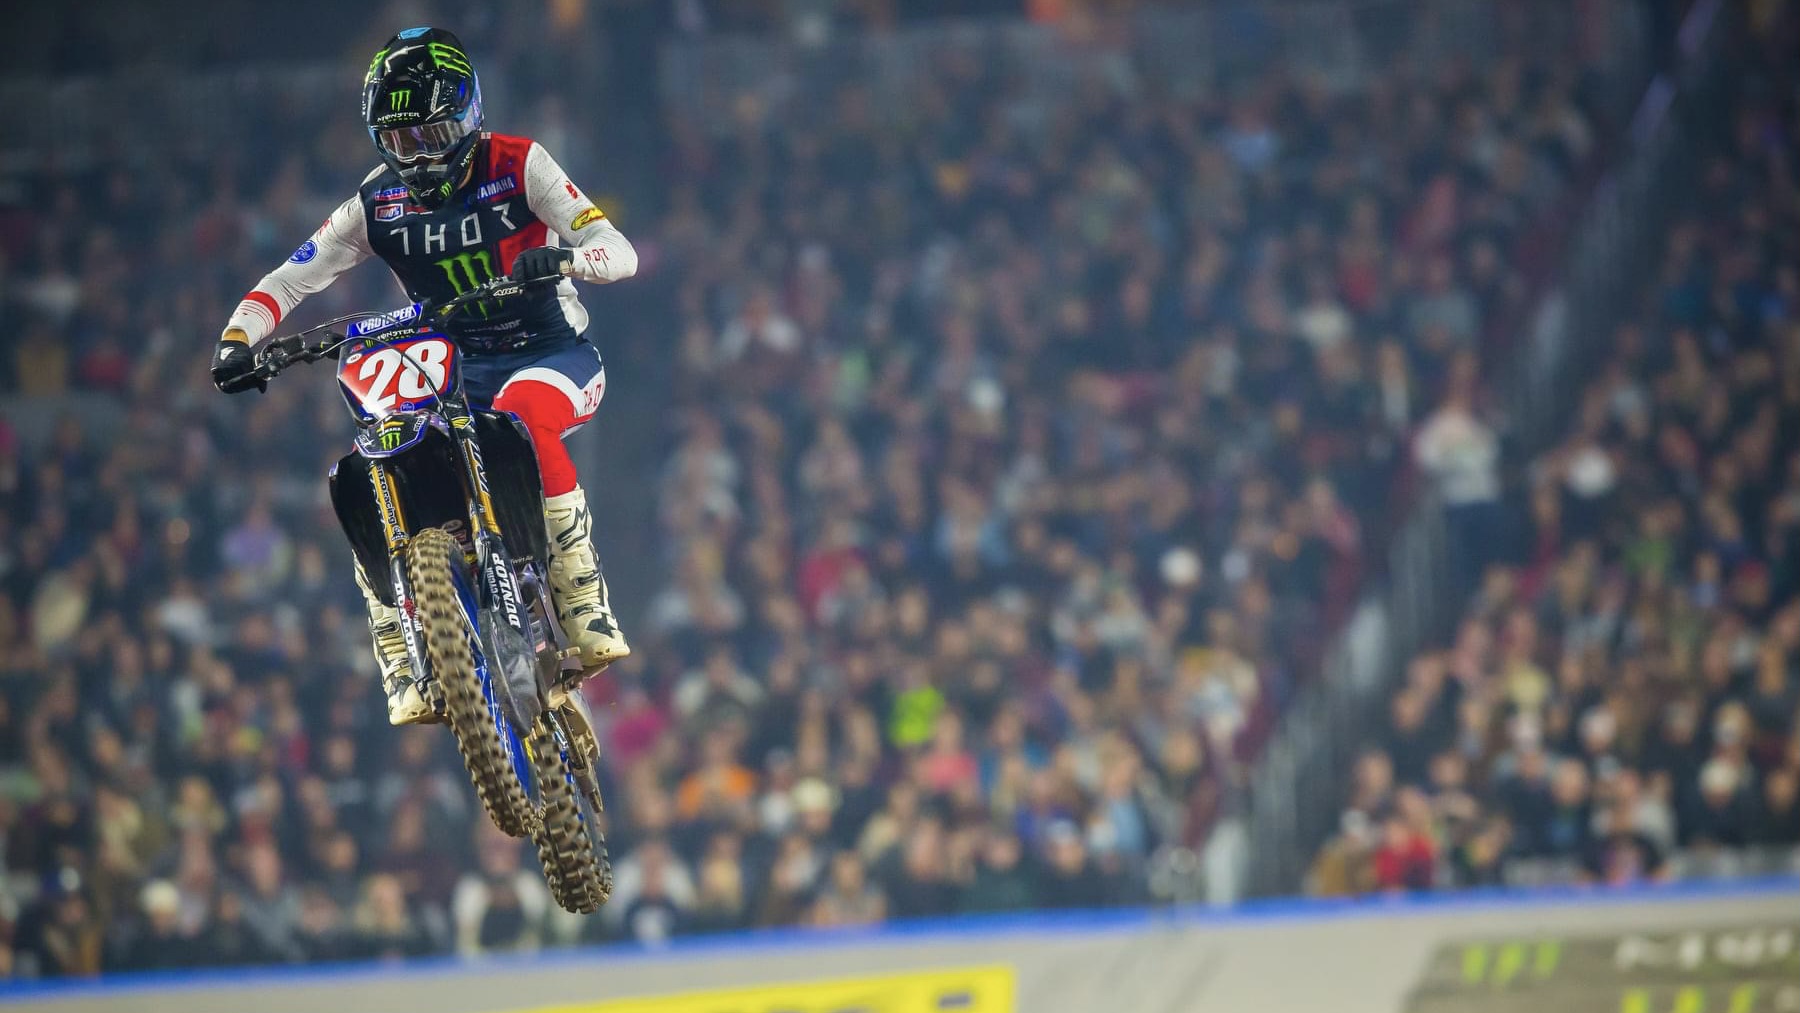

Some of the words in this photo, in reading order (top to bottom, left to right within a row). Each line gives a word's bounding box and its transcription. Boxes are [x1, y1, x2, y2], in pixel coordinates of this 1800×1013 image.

[359, 340, 448, 409] 28
[394, 582, 416, 657] DUNLOP
[491, 553, 521, 628] DUNLOP
